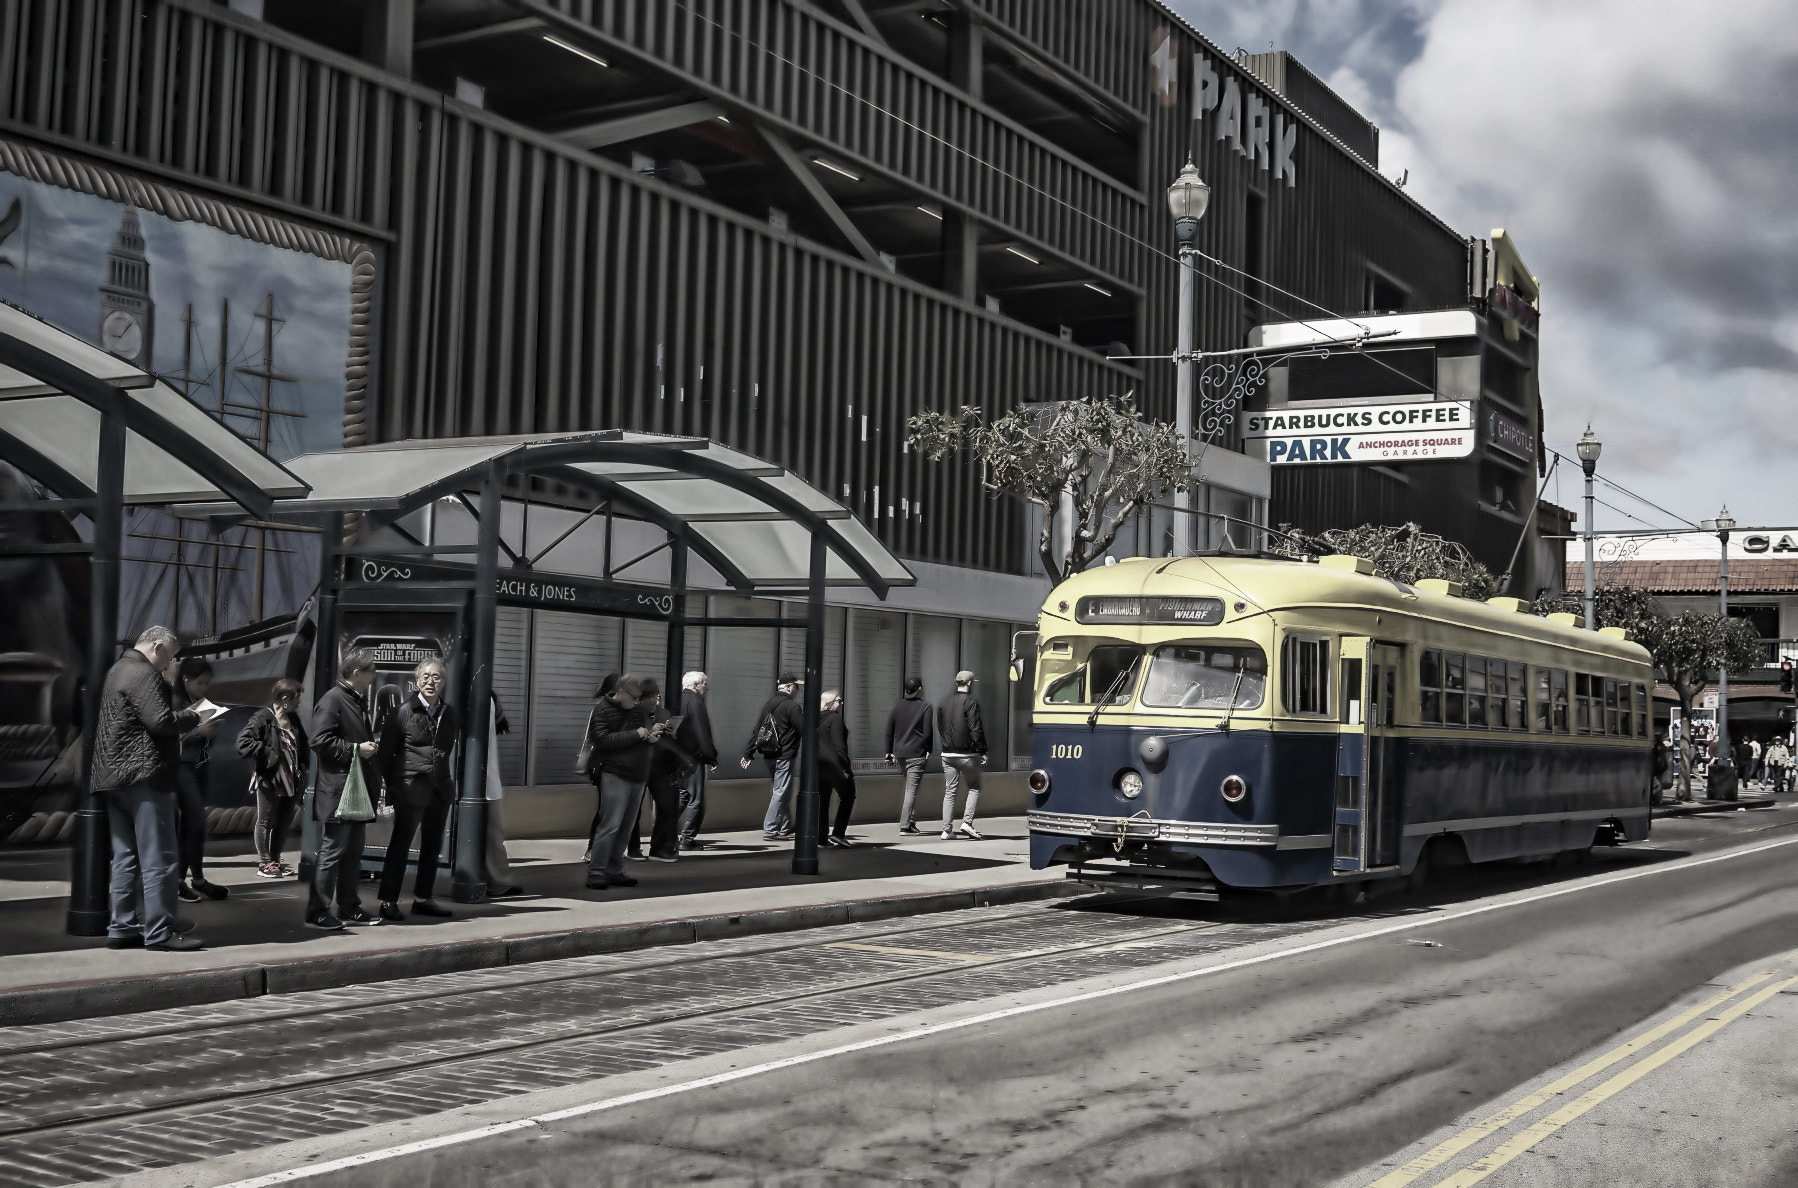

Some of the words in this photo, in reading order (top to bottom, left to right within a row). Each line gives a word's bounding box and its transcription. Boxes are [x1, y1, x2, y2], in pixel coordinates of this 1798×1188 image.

[1193, 53, 1296, 188] PARK
[1248, 411, 1372, 432] STARBUCKS
[1378, 407, 1460, 426] COFFEE
[1357, 440, 1420, 450] ANCHORAGE
[1421, 437, 1463, 447] SQUARE
[1498, 420, 1533, 452] CHIPOTLE
[1269, 437, 1352, 463] PARK
[1382, 448, 1437, 457] GARAGE
[496, 579, 526, 596] EACH
[529, 583, 538, 597] &
[541, 584, 576, 601] JONES
[1088, 601, 1096, 616] E
[1174, 610, 1209, 620] WHARF
[373, 649, 394, 661] SON
[1051, 744, 1083, 760] 1010
